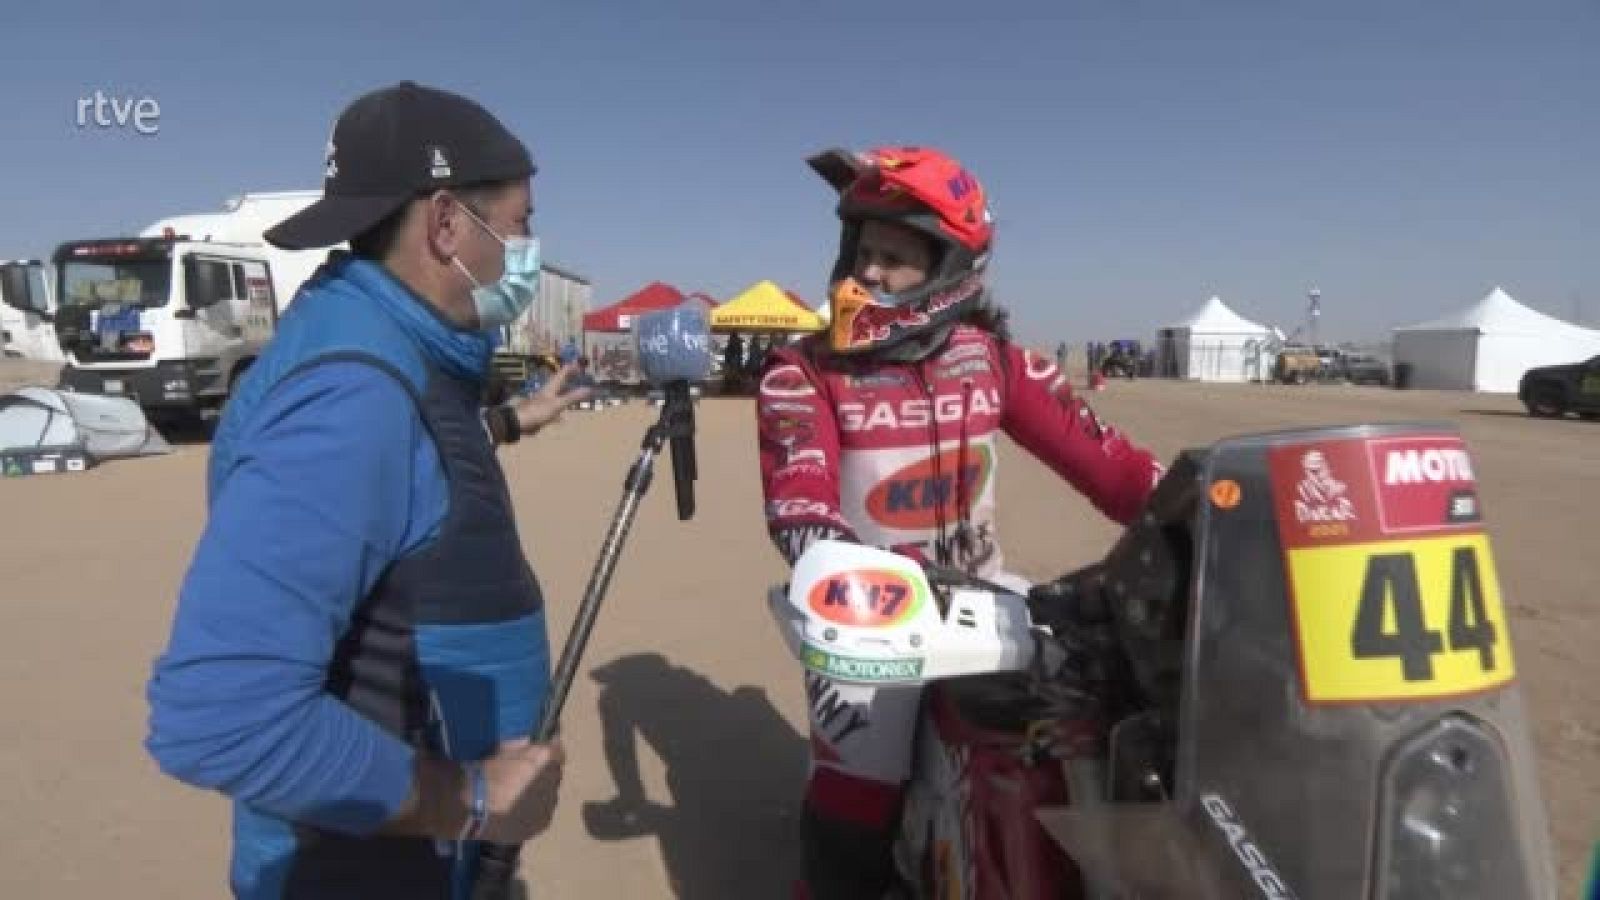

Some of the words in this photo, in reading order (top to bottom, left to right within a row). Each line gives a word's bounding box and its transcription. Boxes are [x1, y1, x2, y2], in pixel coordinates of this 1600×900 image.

[885, 463, 982, 513] KH7
[1352, 545, 1496, 681] 44
[829, 653, 922, 680] MOTOREX
